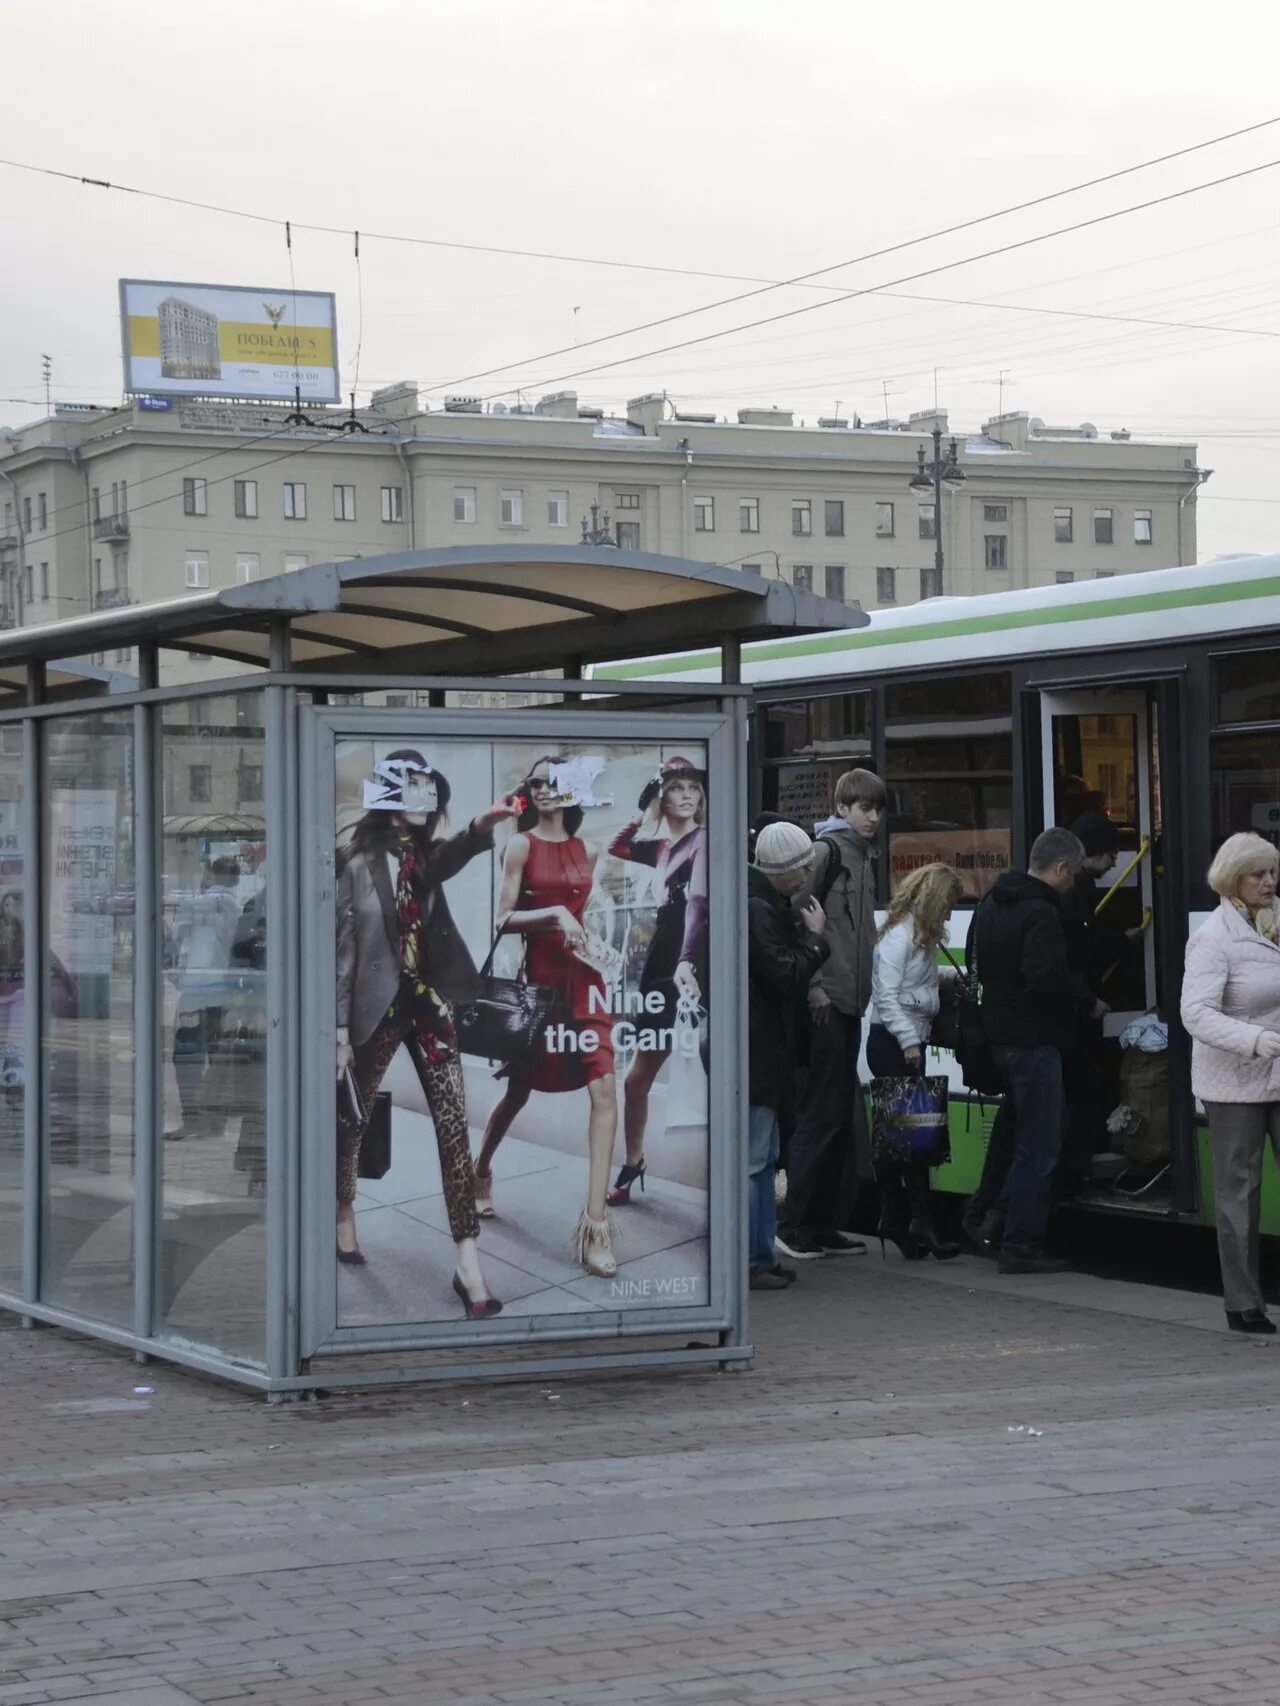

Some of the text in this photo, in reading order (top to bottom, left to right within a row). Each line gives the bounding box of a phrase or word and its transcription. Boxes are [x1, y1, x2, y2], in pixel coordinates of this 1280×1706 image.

[587, 984, 701, 1015] Nine &
[545, 1022, 701, 1058] the Gang
[611, 1276, 698, 1297] NINE WEST
